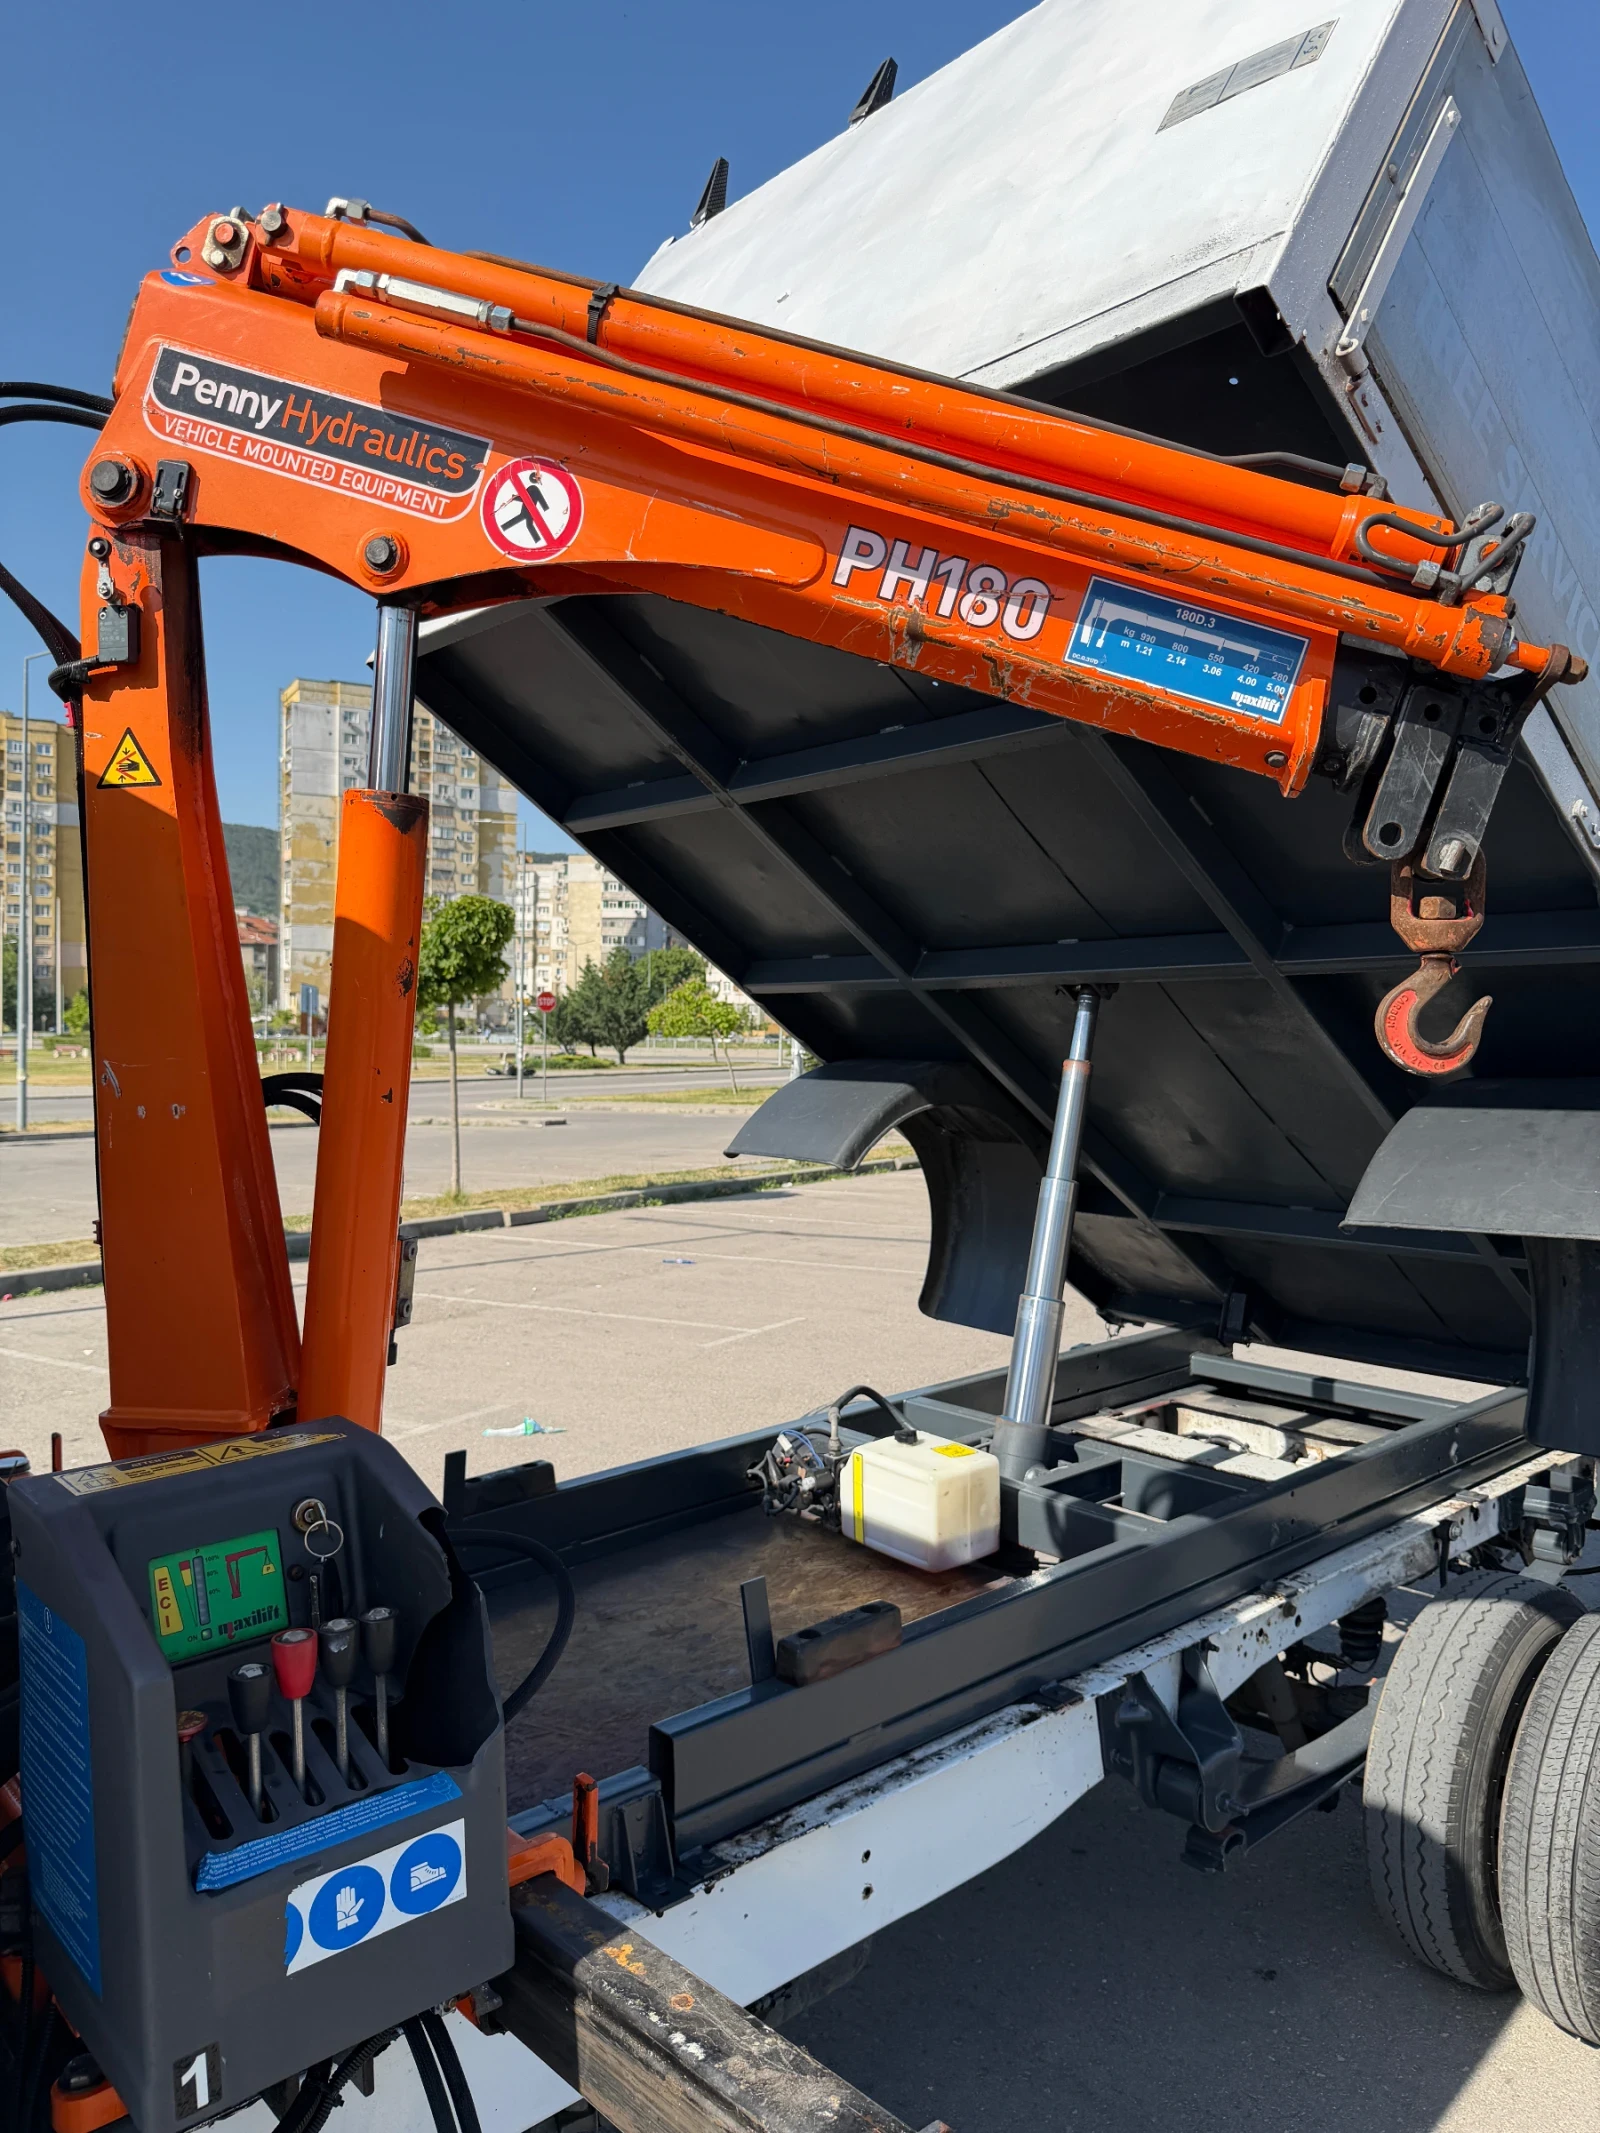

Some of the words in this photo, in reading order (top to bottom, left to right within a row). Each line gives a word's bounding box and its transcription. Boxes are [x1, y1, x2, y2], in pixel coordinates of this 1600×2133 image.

[163, 412, 239, 455] VEHICLE
[243, 435, 336, 481] MOUNTED
[339, 467, 451, 518] EQUIPMENT
[831, 523, 1052, 642] PH180
[1175, 606, 1217, 630] 180D.3
[1120, 639, 1130, 649] m
[1135, 643, 1153, 657] 1.21
[1165, 653, 1187, 667] 2.14
[1202, 663, 1223, 677] 3.06
[1236, 674, 1257, 687] 4.00
[1265, 682, 1286, 696] 5.00
[1123, 626, 1136, 638] kg
[1171, 642, 1189, 654] 800
[1207, 652, 1225, 664] 550
[1242, 663, 1260, 675] 420
[1271, 671, 1289, 683] 280
[1230, 690, 1281, 714] maxilift
[538, 996, 556, 1006] STOP
[217, 1603, 280, 1641] maxilift
[181, 2052, 209, 2110] 1
